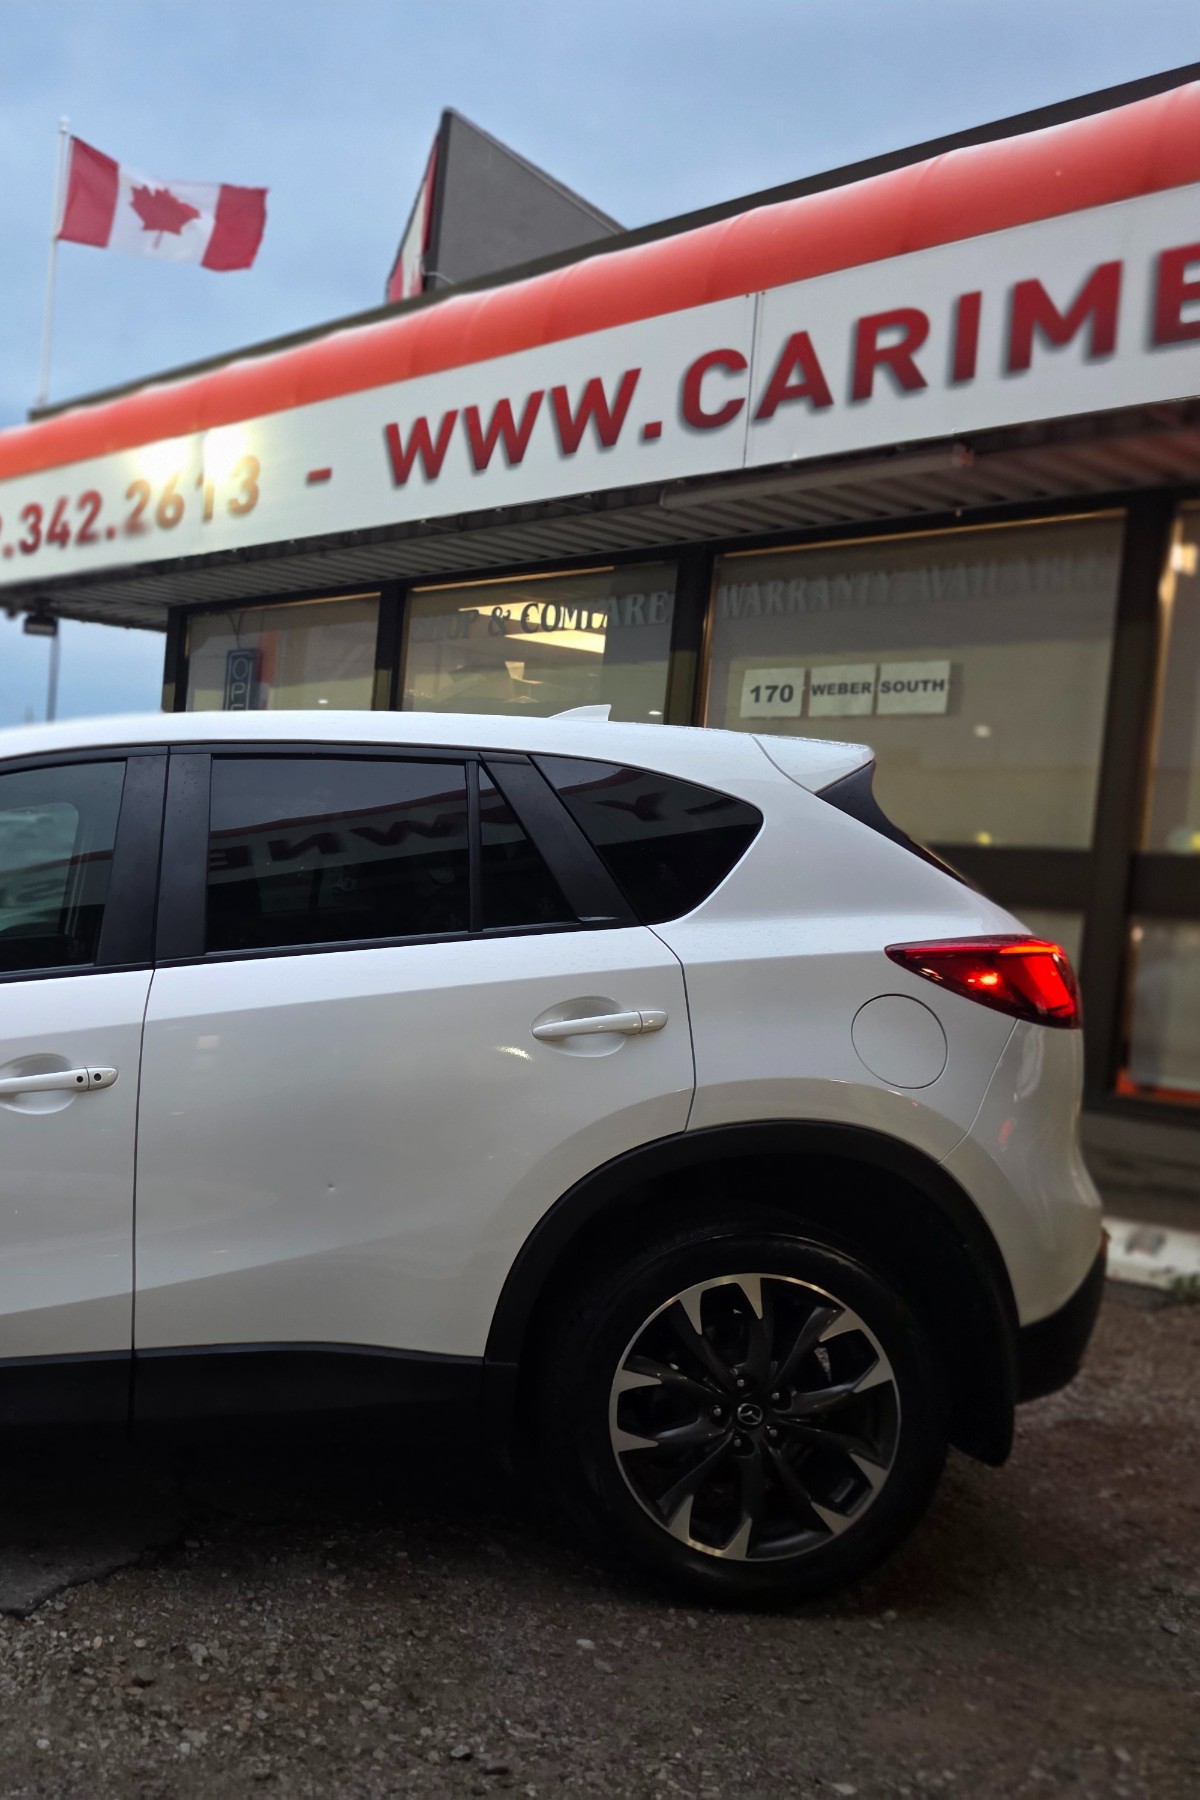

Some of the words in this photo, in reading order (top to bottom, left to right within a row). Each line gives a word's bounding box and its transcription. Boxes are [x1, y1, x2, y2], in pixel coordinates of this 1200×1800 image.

[749, 683, 795, 704] 170
[810, 680, 872, 697] WEBER
[880, 678, 946, 695] SOUTH
